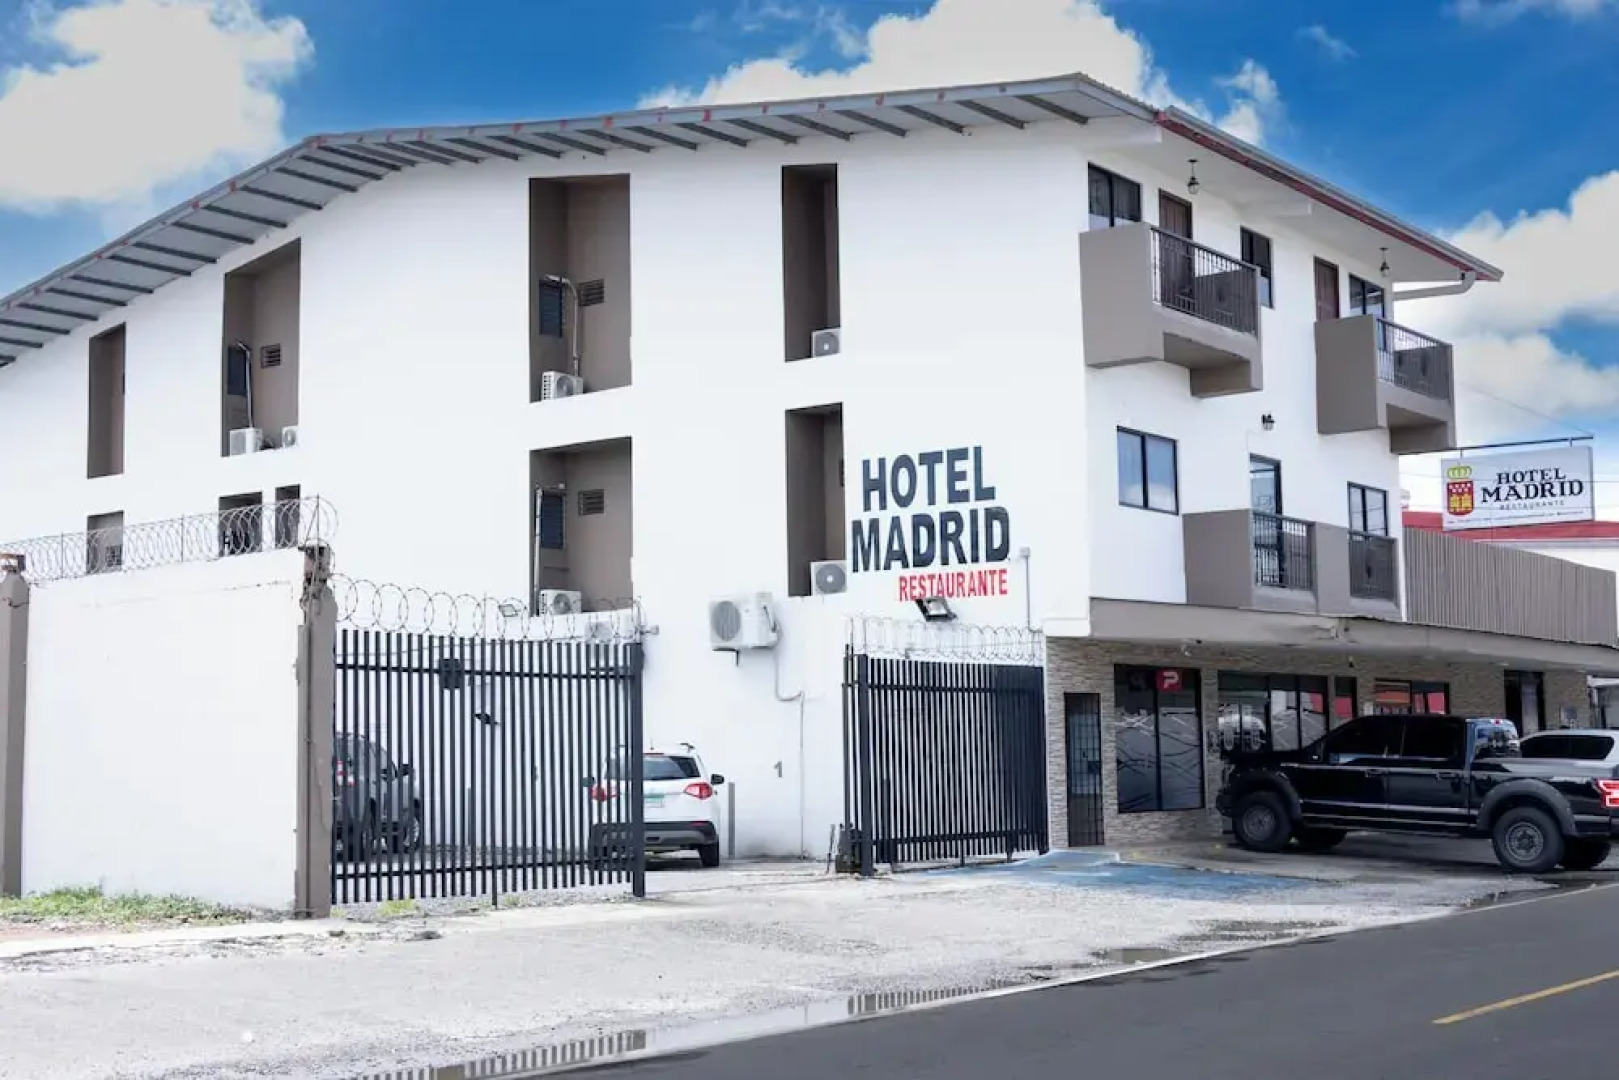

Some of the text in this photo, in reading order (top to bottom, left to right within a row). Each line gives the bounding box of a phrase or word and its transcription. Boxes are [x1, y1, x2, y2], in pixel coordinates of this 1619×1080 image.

[862, 445, 996, 512] HOTEL
[1496, 467, 1566, 484] HOTEL
[1480, 480, 1584, 503] MADRID
[1500, 500, 1565, 511] RESTAURANTE
[852, 506, 1010, 573] MADRID
[898, 568, 1008, 602] RESTAURANTE
[773, 760, 783, 778] 1
